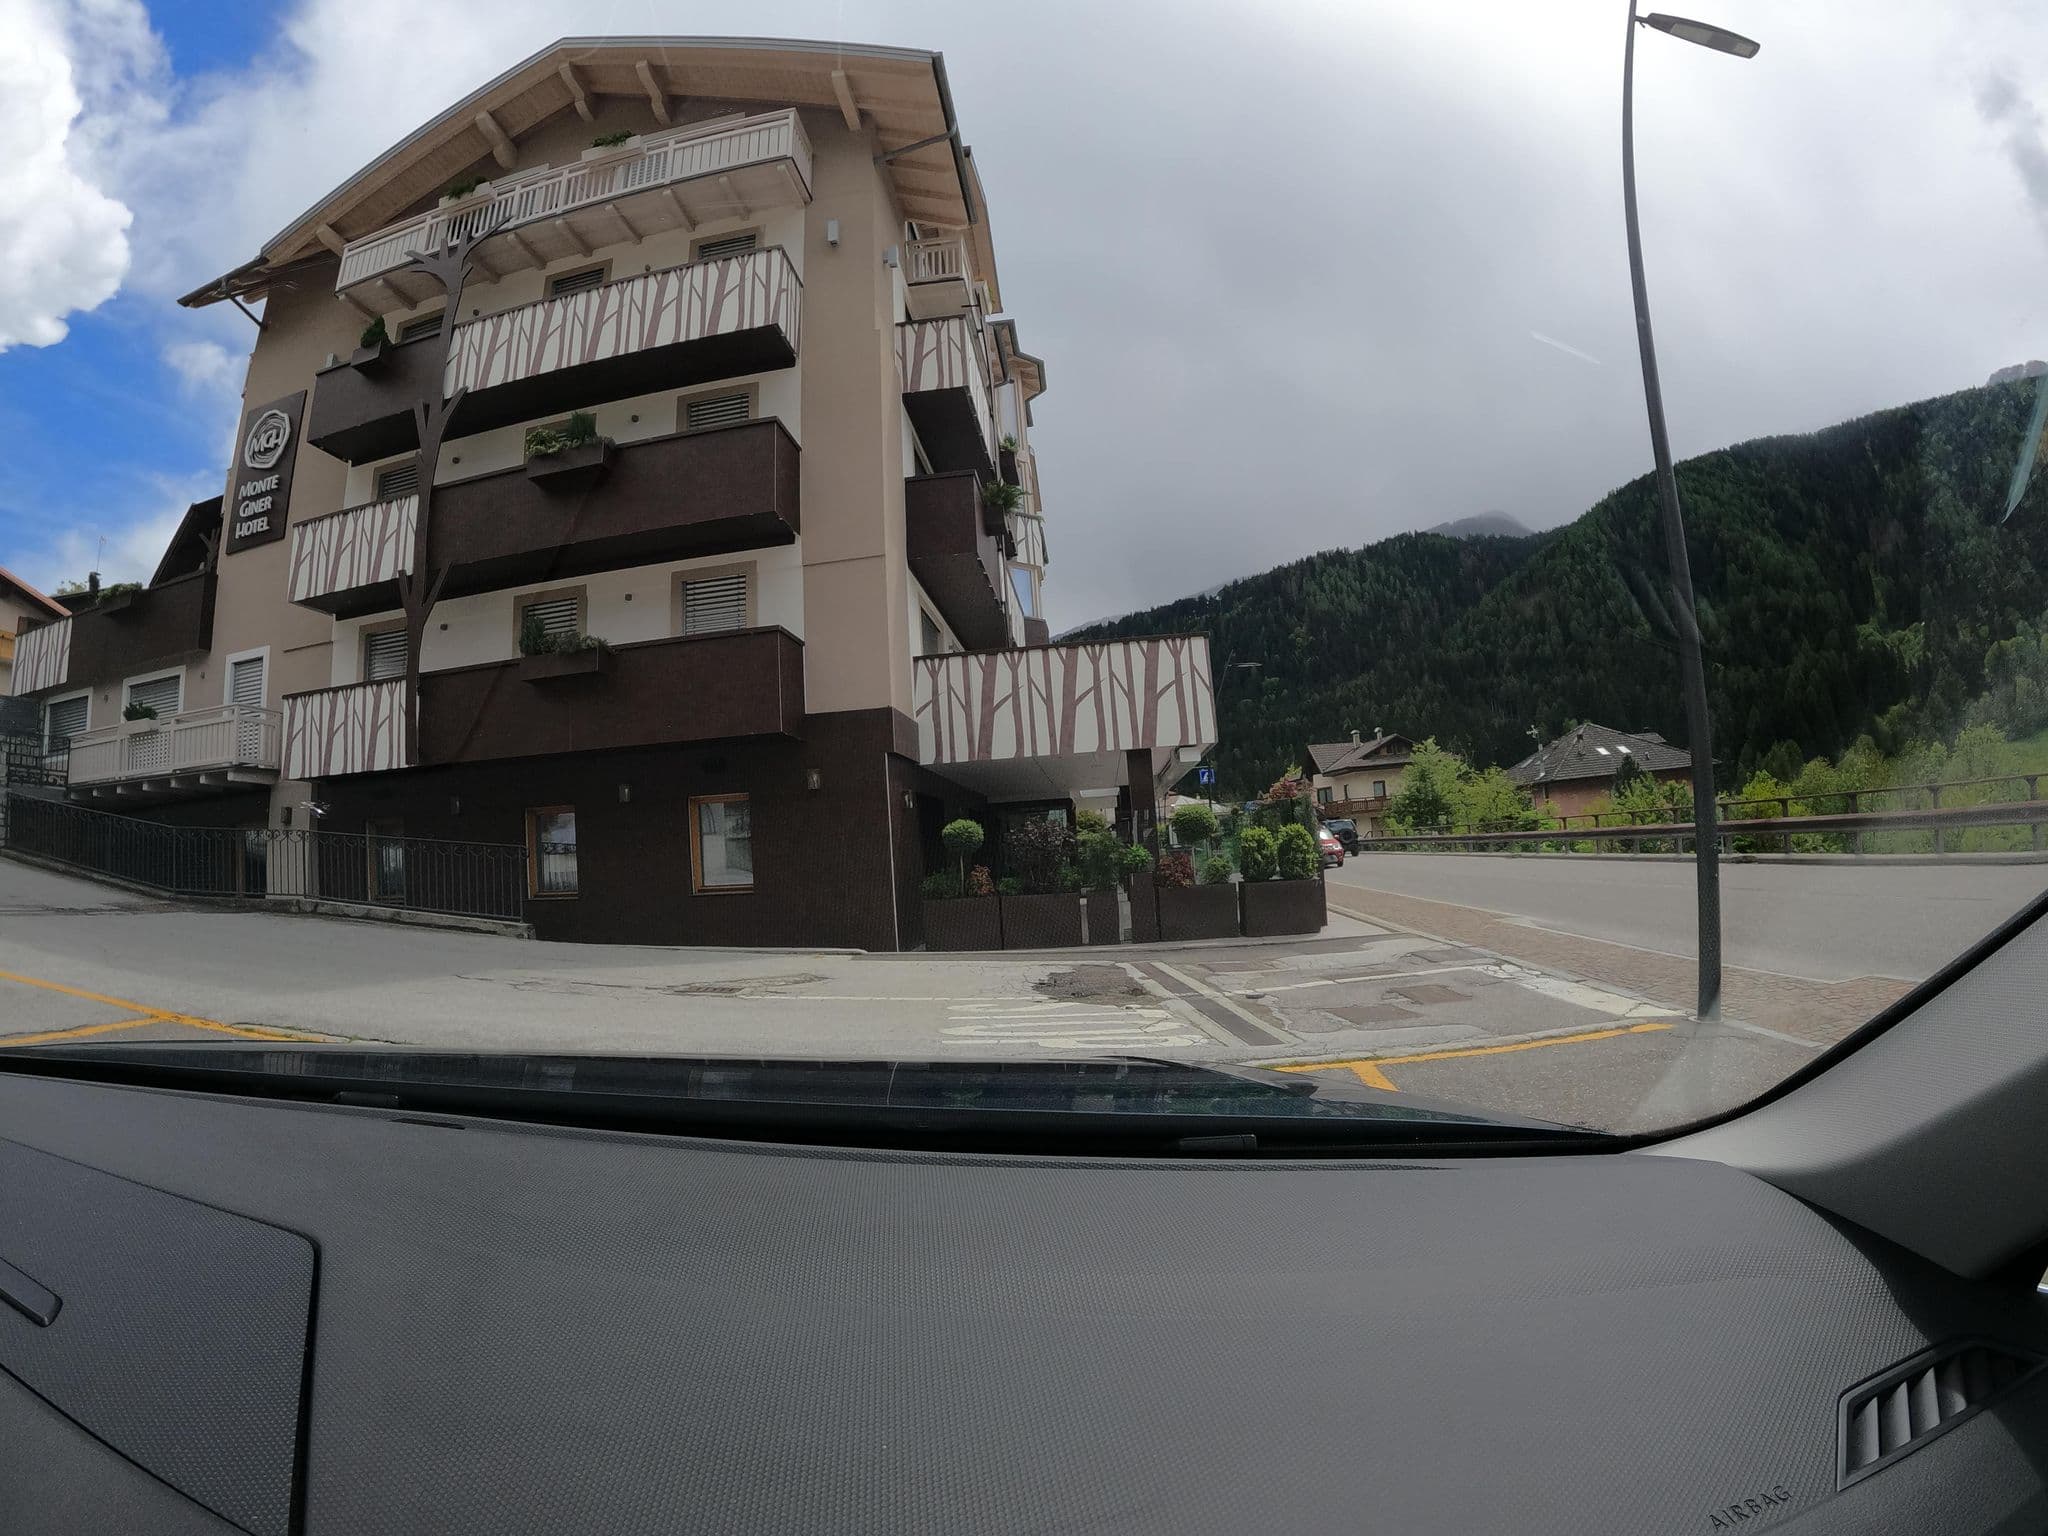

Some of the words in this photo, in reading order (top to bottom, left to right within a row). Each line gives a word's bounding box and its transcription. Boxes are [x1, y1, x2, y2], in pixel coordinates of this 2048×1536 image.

[238, 474, 280, 500] MONTE
[239, 496, 272, 518] GINER
[235, 516, 270, 539] HOTEL
[1709, 1485, 1792, 1531] AIRBAG
